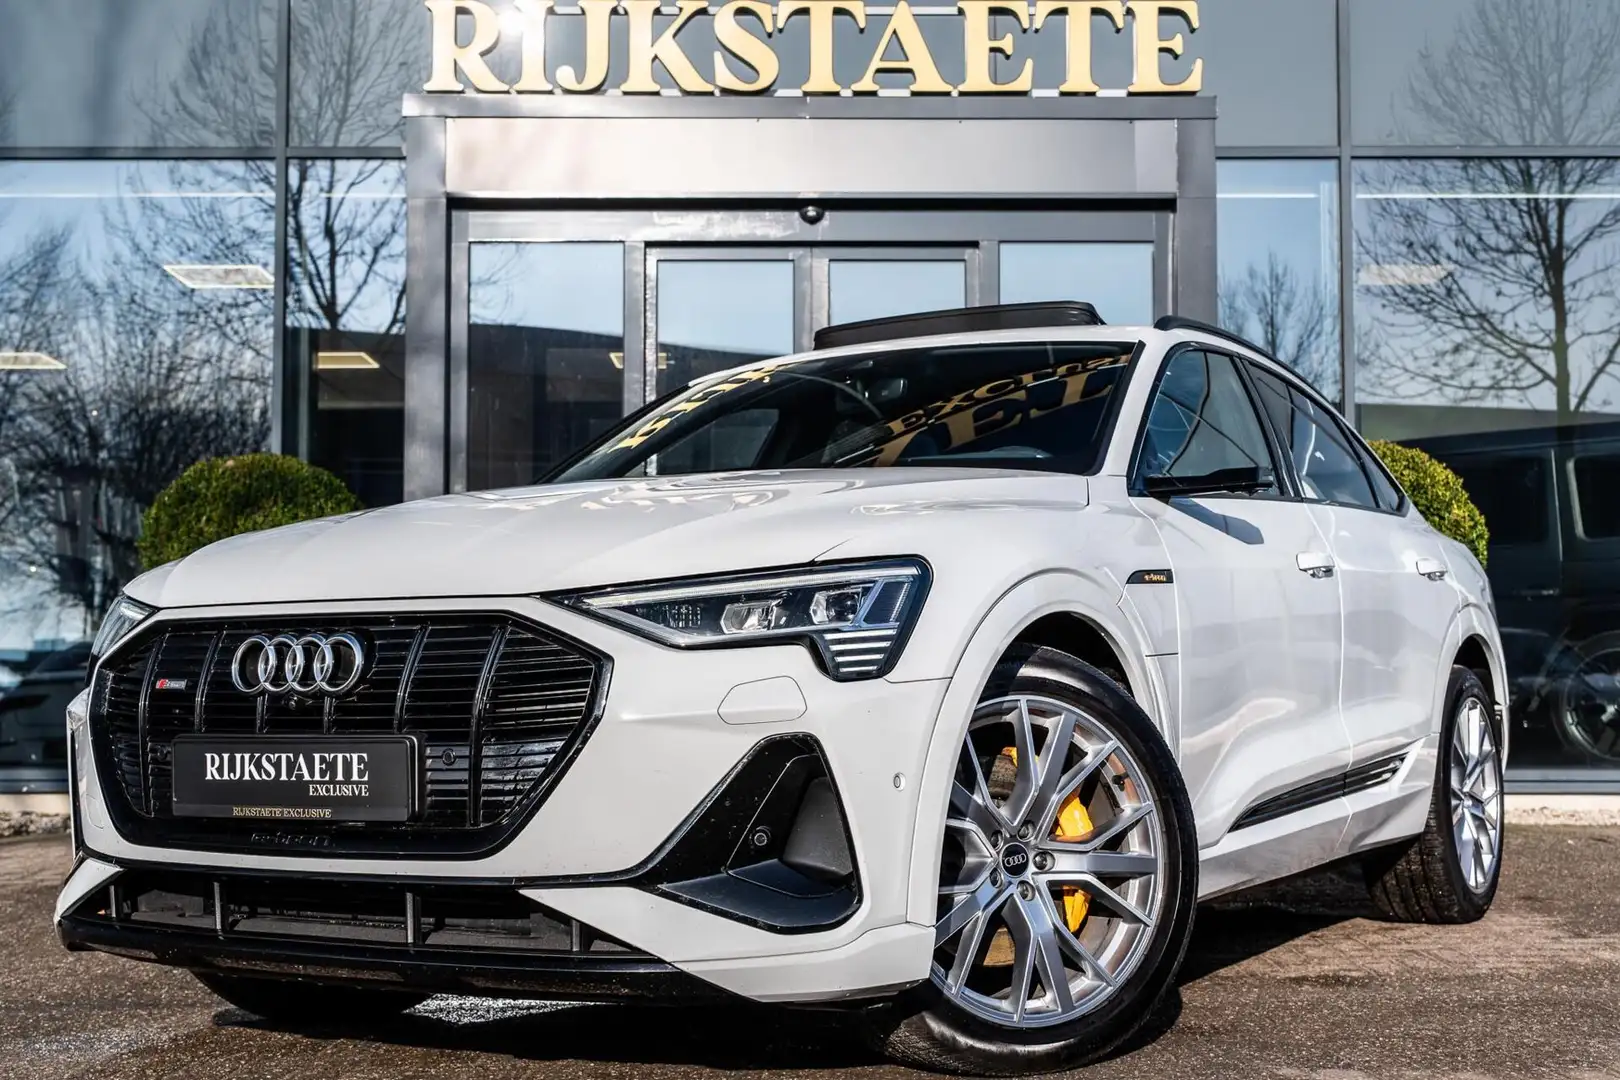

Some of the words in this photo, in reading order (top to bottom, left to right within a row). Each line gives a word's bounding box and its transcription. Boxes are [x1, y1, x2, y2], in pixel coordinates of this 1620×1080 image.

[422, 0, 1204, 96] RIJKSTAETE
[204, 752, 370, 781] RIJKSTAETE
[308, 784, 370, 797] EXCLUSIVE
[232, 806, 282, 818] RIJKSTAETE
[283, 808, 332, 818] EXCLUSIVE
